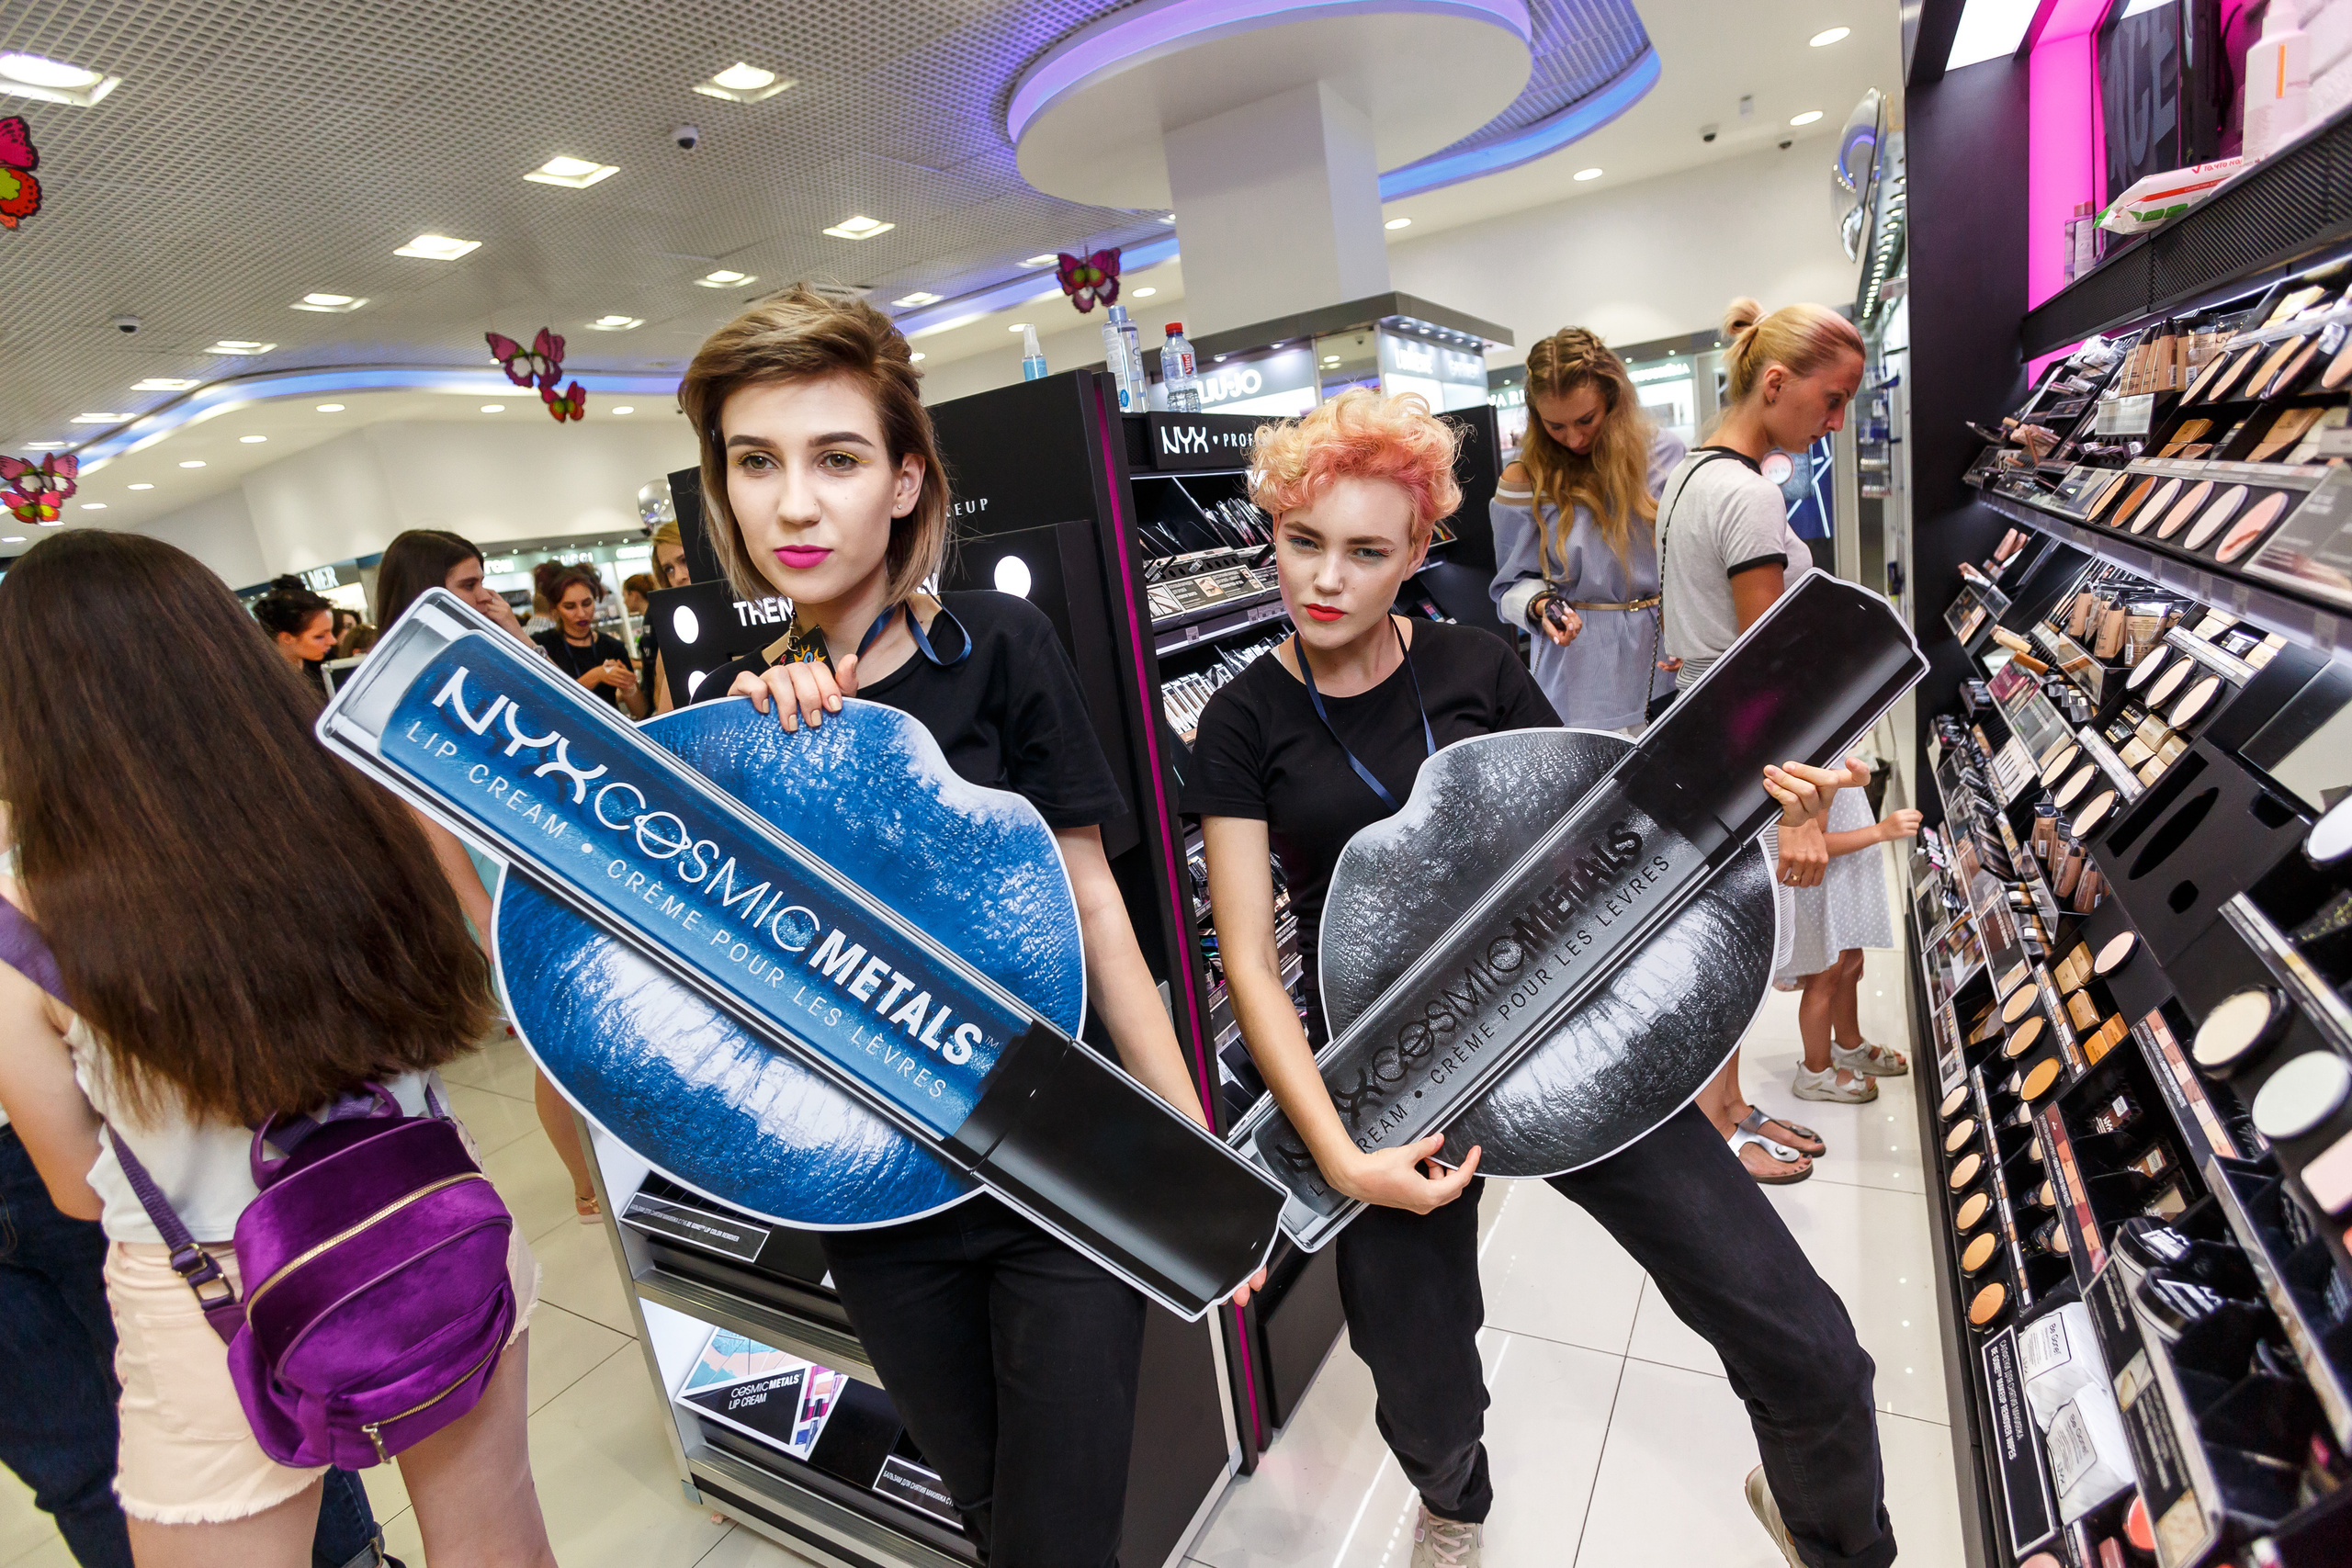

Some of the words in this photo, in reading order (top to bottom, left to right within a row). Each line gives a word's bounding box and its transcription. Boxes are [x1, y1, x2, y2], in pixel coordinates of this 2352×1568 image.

[1160, 425, 1209, 454] NYX
[432, 666, 607, 805] NYX
[405, 720, 458, 761] LIP
[468, 763, 568, 840] CREAM
[607, 858, 702, 930] CRÈME
[711, 928, 786, 987] POUR
[792, 984, 842, 1027] LES
[852, 1026, 949, 1100] LÈVRES
[1356, 1104, 1408, 1154] REAM
[1430, 1021, 1495, 1086] CRÈME
[1498, 966, 1553, 1022] POUR
[1555, 929, 1593, 968] LES
[1596, 854, 1670, 927] LÈVRES
[1991, 1346, 1997, 1357] BE
[2000, 1339, 2011, 1371] САЛФЕТКИ
[728, 1398, 741, 1411] LIP
[741, 1393, 767, 1407] CREAM
[1996, 1378, 2007, 1405] MAKEUP
[2007, 1382, 2018, 1407] СНЯТИЯ
[2001, 1404, 2012, 1438] REMOVER
[2012, 1405, 2024, 1441] МАКИЯЖА
[2007, 1436, 2017, 1461] WIPES
[883, 1470, 903, 1484] БАЛЬЗАМ
[900, 1478, 911, 1488] ДЛЯ
[910, 1482, 927, 1495] СНЯТИЯ
[925, 1488, 947, 1504] МАКИЯЖА
